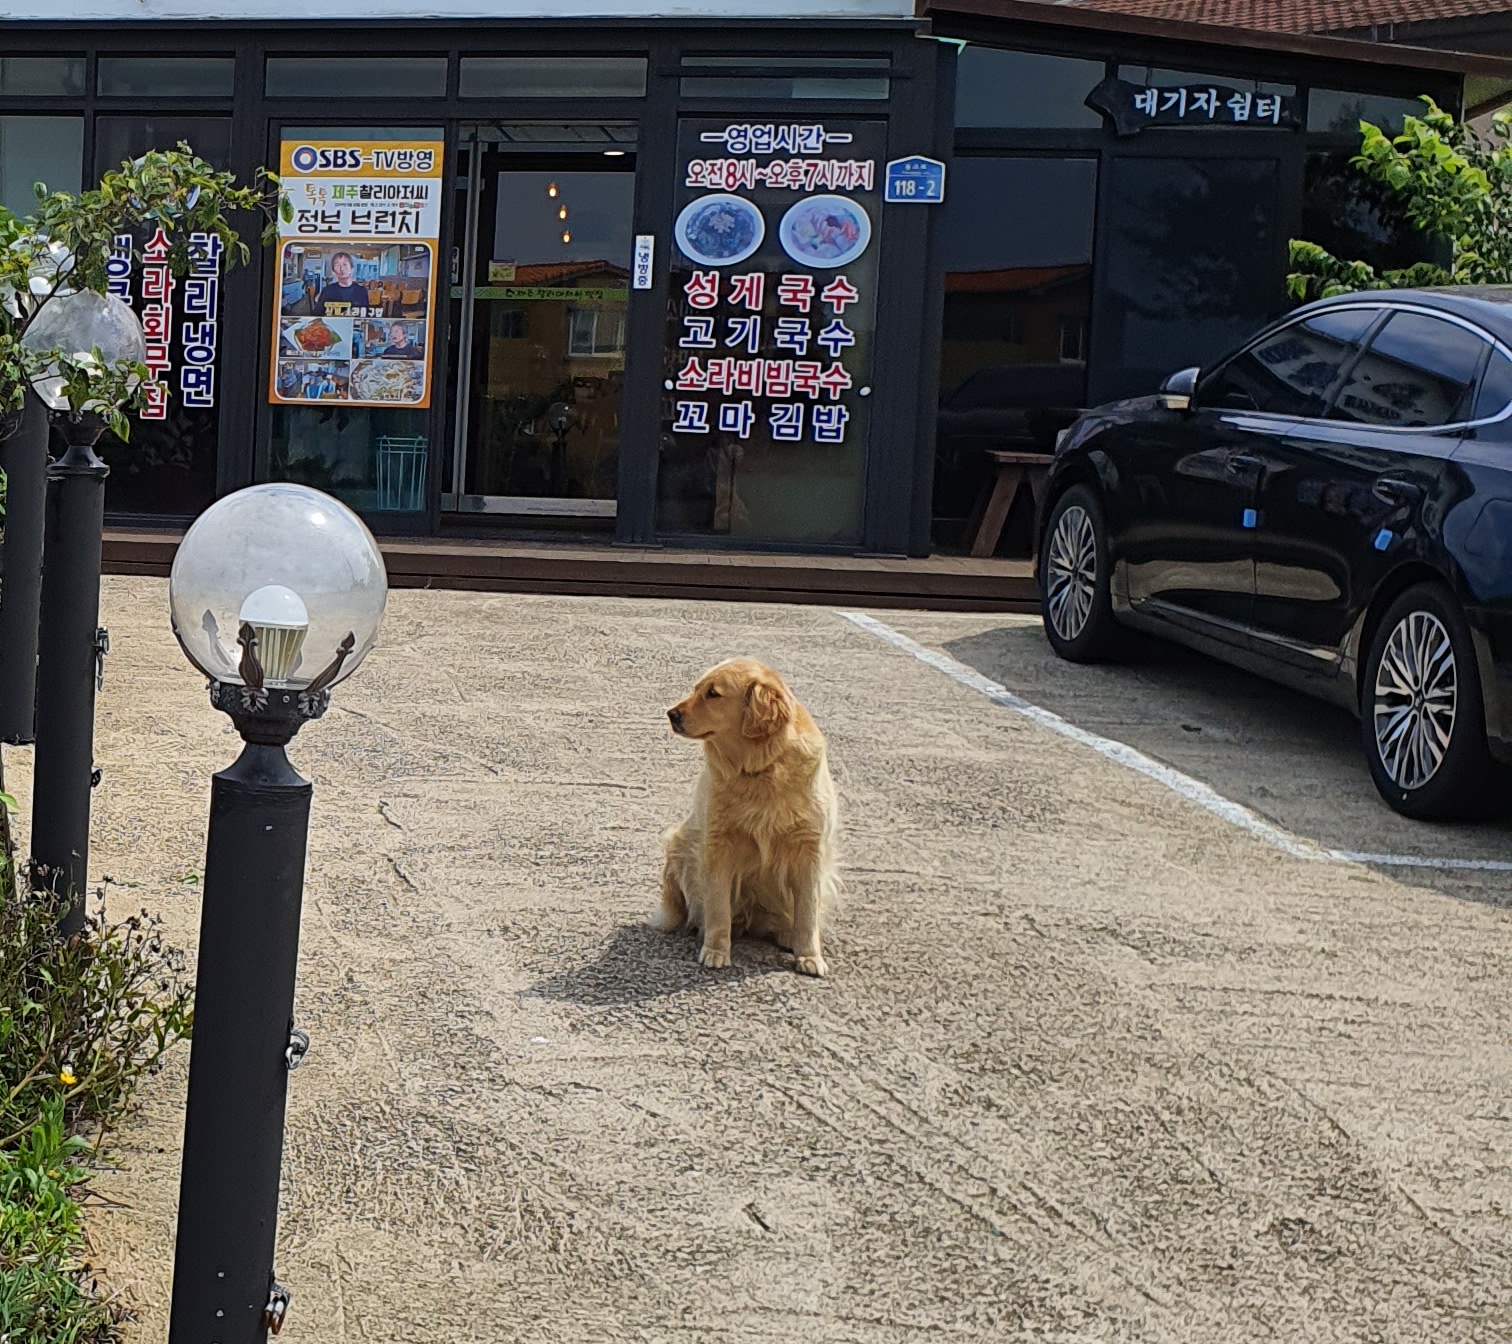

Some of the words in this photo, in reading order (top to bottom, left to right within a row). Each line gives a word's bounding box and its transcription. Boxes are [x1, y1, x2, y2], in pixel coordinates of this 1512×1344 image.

[1134, 88, 1221, 119] 대기자
[318, 148, 434, 171] SBS-TV방영
[331, 184, 429, 200] 제주찰리아저씨
[297, 209, 342, 234] 정보
[348, 210, 420, 235] 브런치
[684, 271, 859, 313] 성게국수
[679, 316, 856, 357] 고기국수
[676, 357, 853, 399] 소라비빔국수
